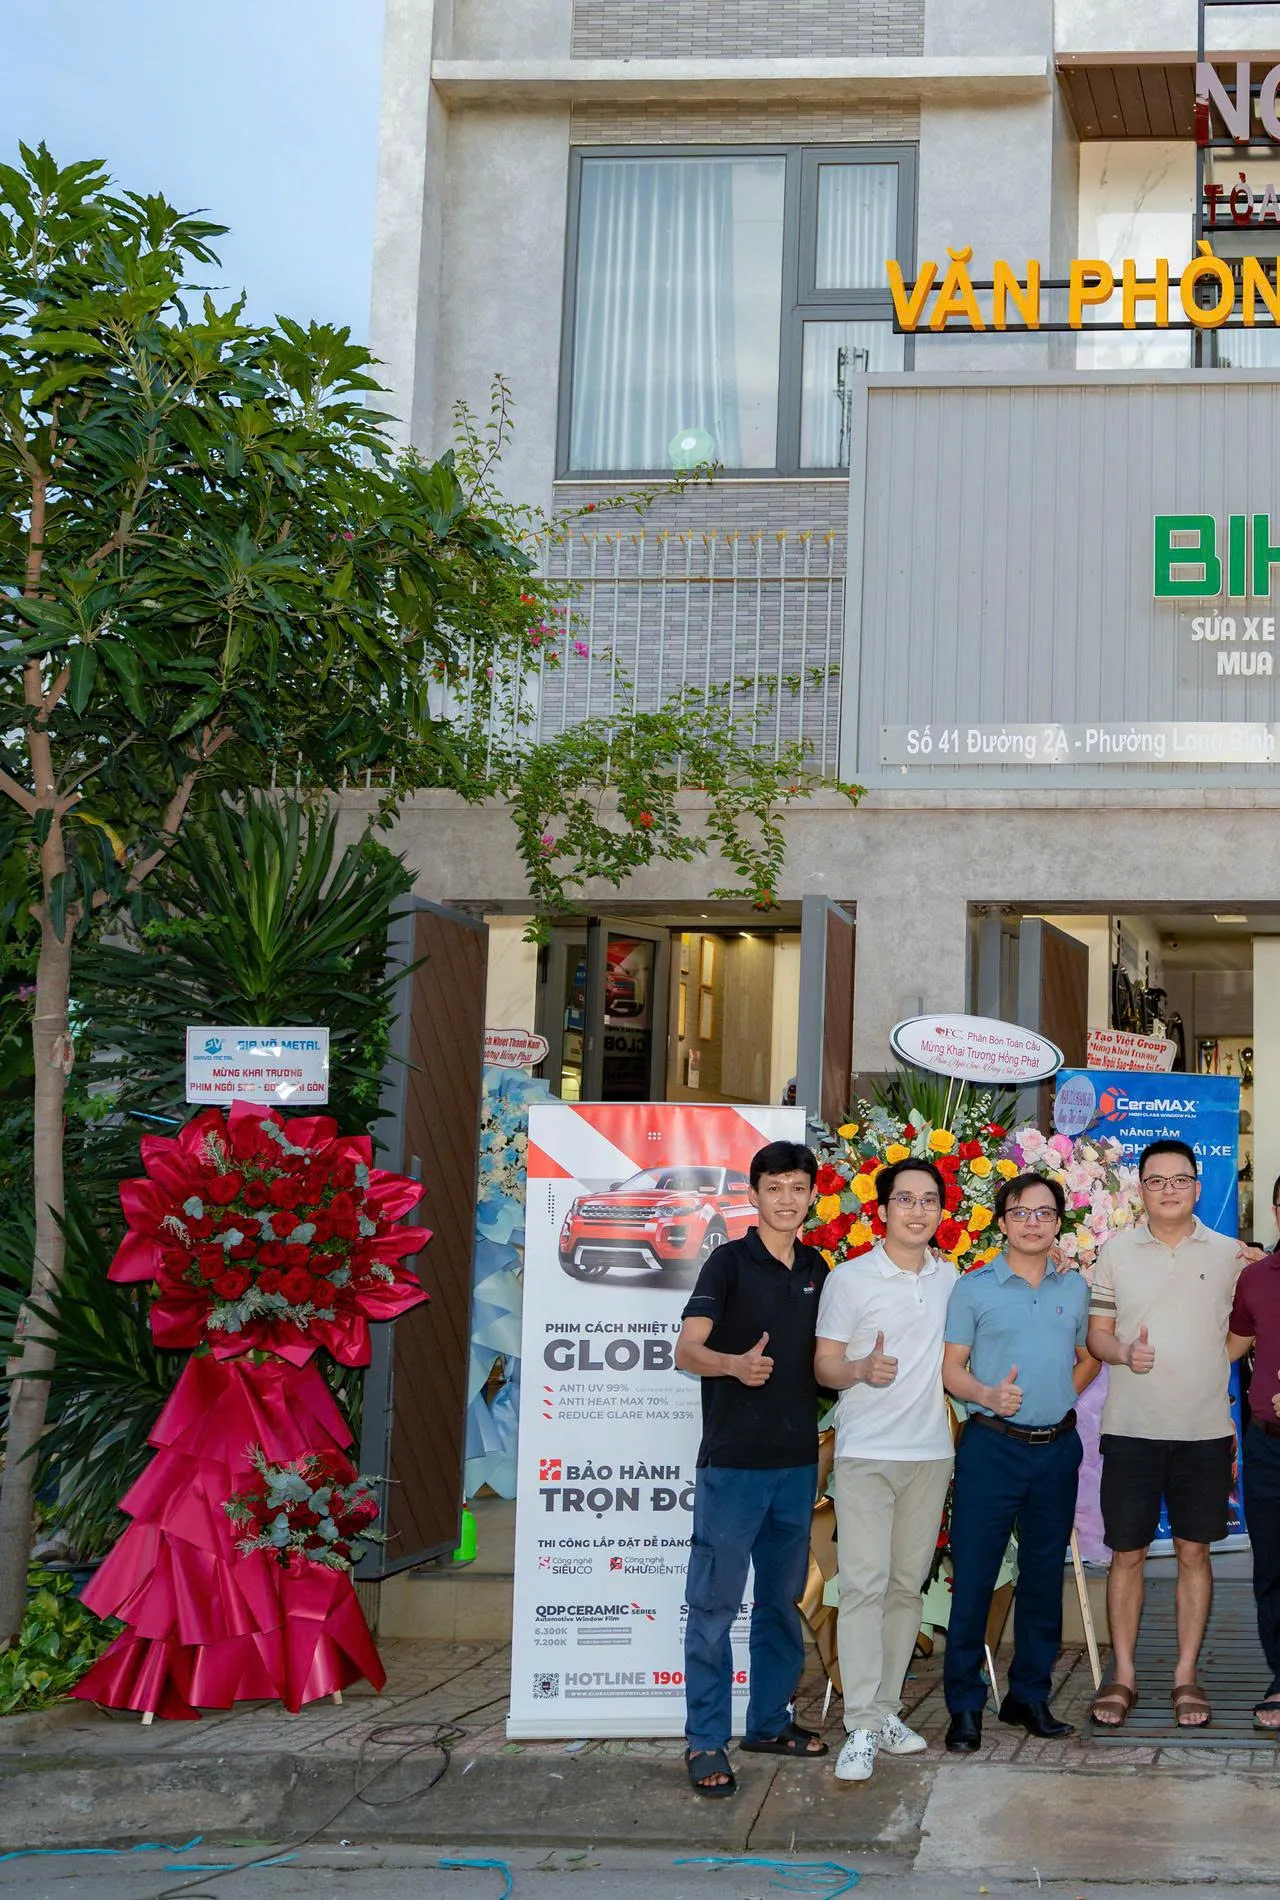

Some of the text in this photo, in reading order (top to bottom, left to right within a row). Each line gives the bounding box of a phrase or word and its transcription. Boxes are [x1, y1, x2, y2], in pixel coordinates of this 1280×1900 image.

[885, 246, 1041, 331] VĂN
[1190, 609, 1237, 642] SỬA
[1242, 616, 1276, 641] XE
[1216, 650, 1273, 676] MUA
[906, 727, 934, 756] Số
[938, 729, 961, 754] 41
[966, 727, 1037, 757] Đường
[1042, 730, 1070, 753] 2A
[1084, 727, 1167, 757] Phường
[281, 1040, 321, 1051] METAL
[920, 1039, 945, 1057] Mừng
[946, 1045, 965, 1057] Khai
[1094, 1031, 1113, 1044] Tạo
[1115, 1034, 1135, 1047] Việt
[1137, 1039, 1167, 1053] Group
[1112, 1046, 1130, 1057] Khai
[212, 1066, 240, 1077] MỪNG
[242, 1069, 263, 1077] KHAI
[189, 1082, 212, 1092] PHIM
[214, 1081, 235, 1092] NGÔI
[307, 1081, 325, 1092] GÒN
[1116, 1097, 1196, 1112] CeraMAX
[1120, 1126, 1180, 1137] NÂNG TẦM
[1210, 1145, 1232, 1156] XE
[545, 1321, 668, 1336] PHIM CÁCH NHIỆT
[543, 1338, 684, 1372] GLOB
[559, 1384, 585, 1393] ANTI
[587, 1384, 604, 1393] UV
[606, 1383, 630, 1393] 99%
[558, 1397, 585, 1406] ANTI
[587, 1397, 617, 1406] HEAT
[620, 1397, 644, 1406] MAX
[646, 1397, 669, 1406] 70%
[558, 1410, 694, 1420] REDUCE GLARE MAX 93%
[566, 1460, 680, 1481] BẢO HÀNH
[539, 1487, 640, 1519] TRỌN
[537, 1535, 693, 1549] THI CÔNG LẮP ĐẶT DỄ DÀNG
[552, 1557, 593, 1566] Công nghệ
[624, 1556, 664, 1565] Công nghệ
[534, 1627, 568, 1635] 6.300K
[564, 1672, 646, 1686] HOTLINE
